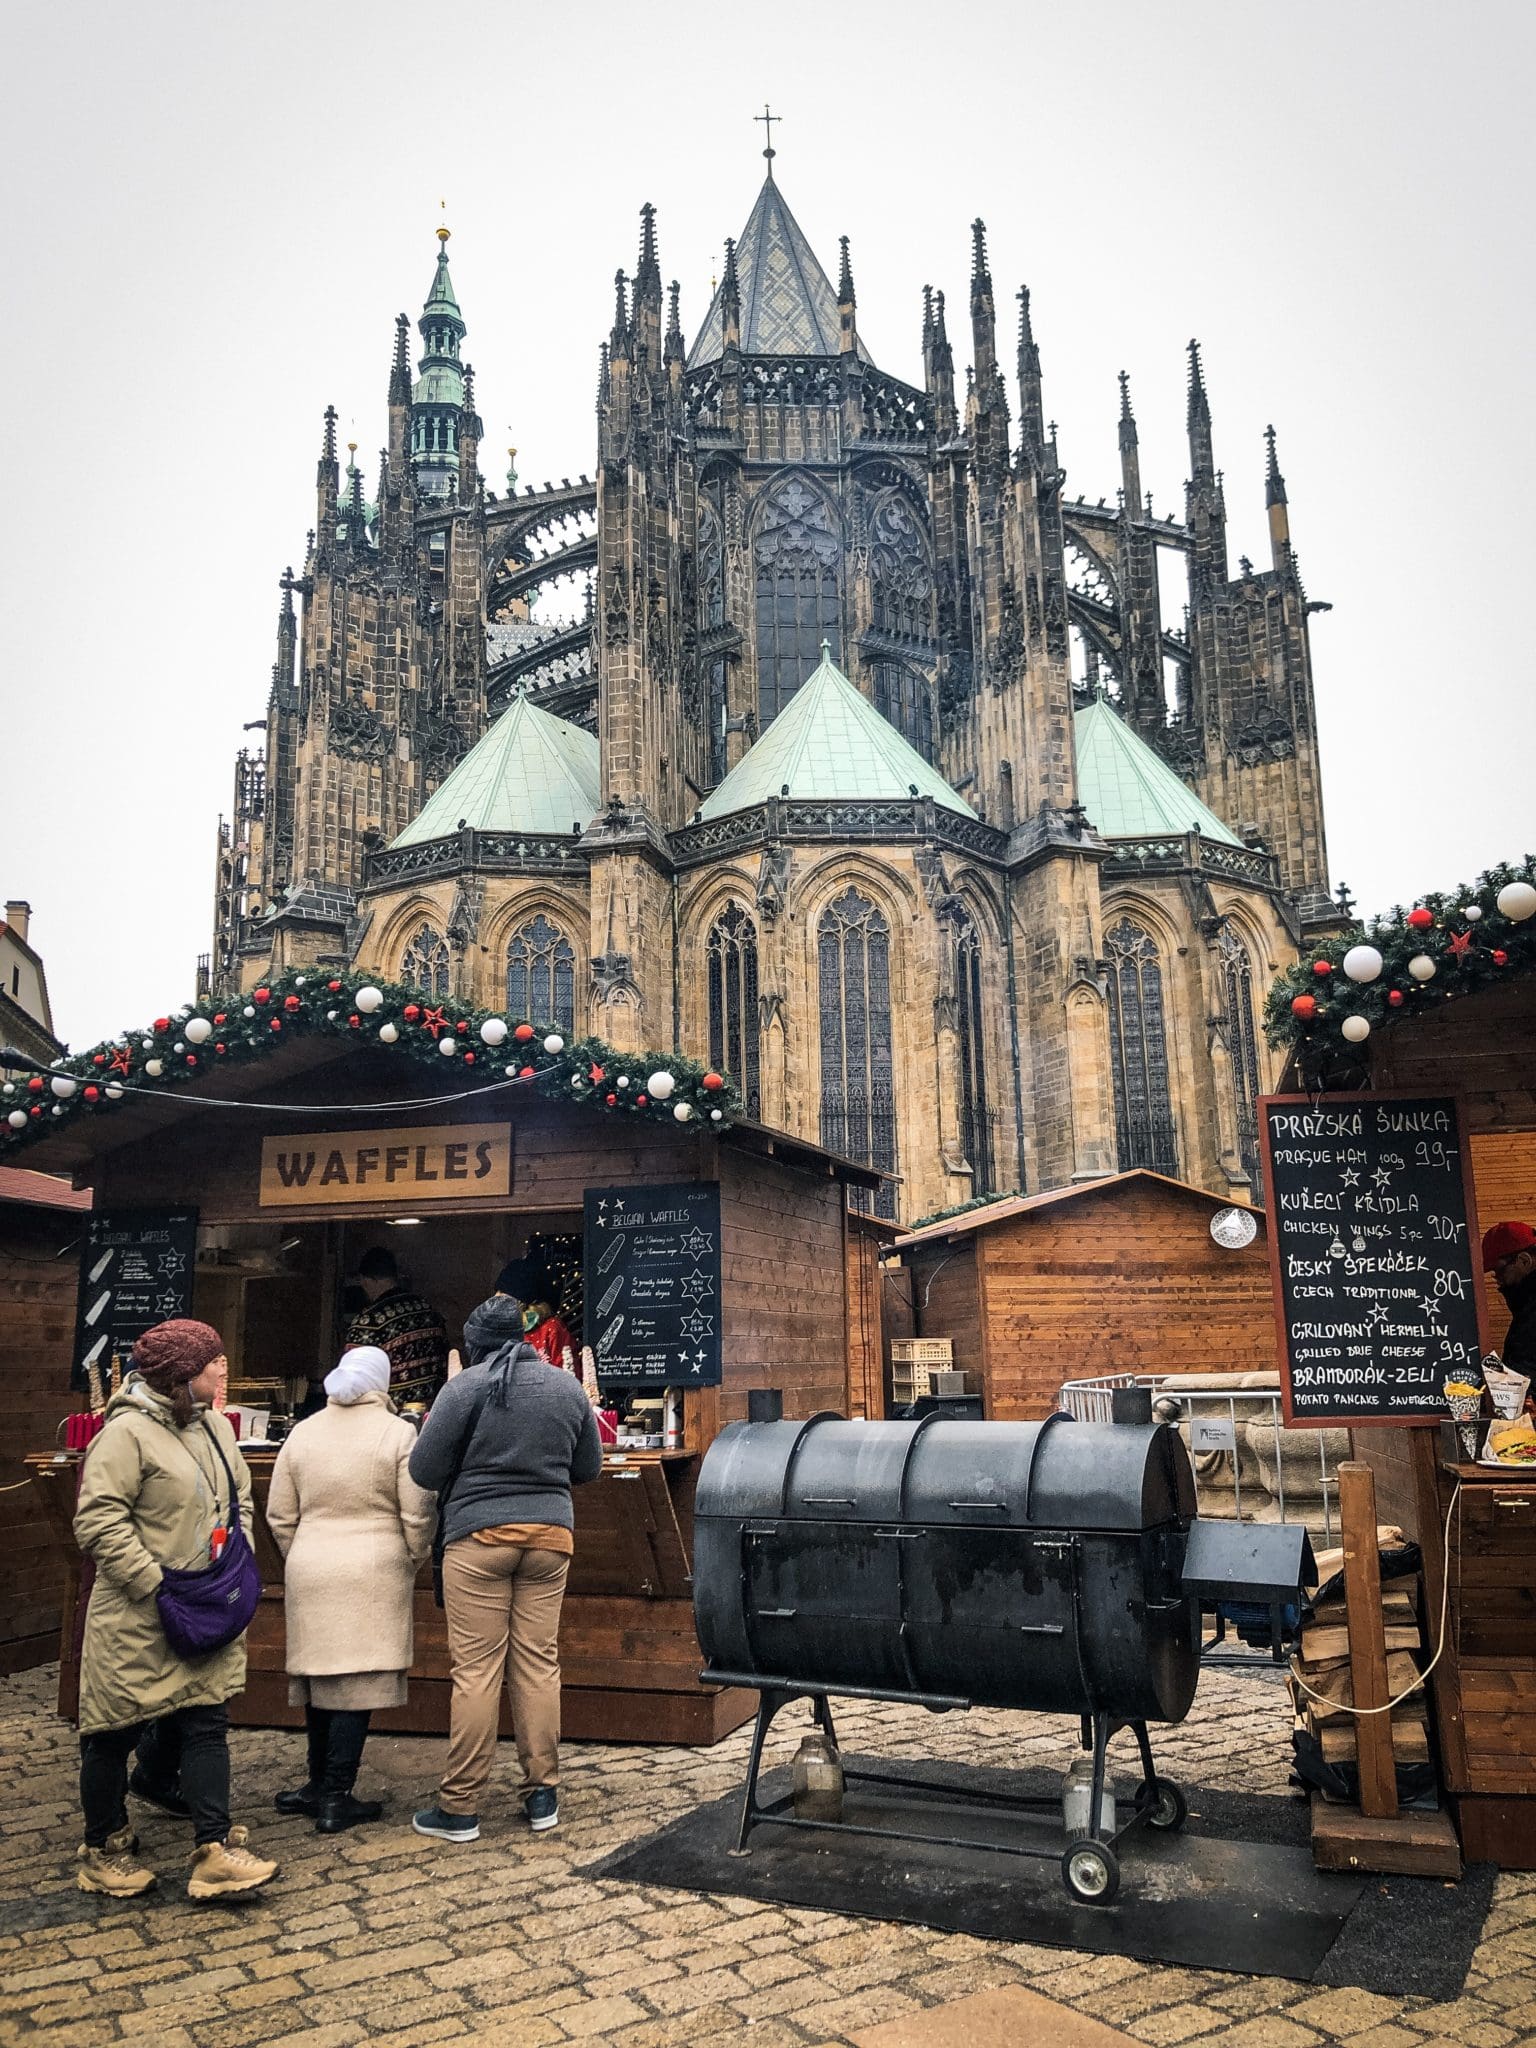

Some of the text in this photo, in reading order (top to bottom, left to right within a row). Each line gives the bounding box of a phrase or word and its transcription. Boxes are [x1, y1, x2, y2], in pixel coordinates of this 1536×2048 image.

[1269, 1106, 1450, 1138] PRAŽSKÁ ŠUNKA
[277, 1141, 492, 1187] WAFFLES
[1274, 1150, 1331, 1168] PRAGUE
[1336, 1148, 1368, 1164] HAM
[1379, 1153, 1406, 1170] 100g
[1280, 1187, 1419, 1214] KUŘECÍ KŘÍDLA
[650, 1208, 690, 1223] WAFFLES
[1283, 1220, 1339, 1236] CHICKEN
[1350, 1224, 1392, 1240] WINGS
[1287, 1249, 1429, 1278] ČESKÝ ŠPEKÁČEK
[1293, 1286, 1334, 1299] CZECH
[1343, 1286, 1420, 1299] TRADITIONAL
[1291, 1316, 1448, 1340] GRILOVANÝ HERMELÍN
[1295, 1347, 1341, 1362] GRILLED
[1347, 1346, 1373, 1357] BRIE
[1381, 1347, 1426, 1358] CHEESE
[1295, 1393, 1329, 1405] POTATO
[1334, 1394, 1380, 1405] PANCAKE
